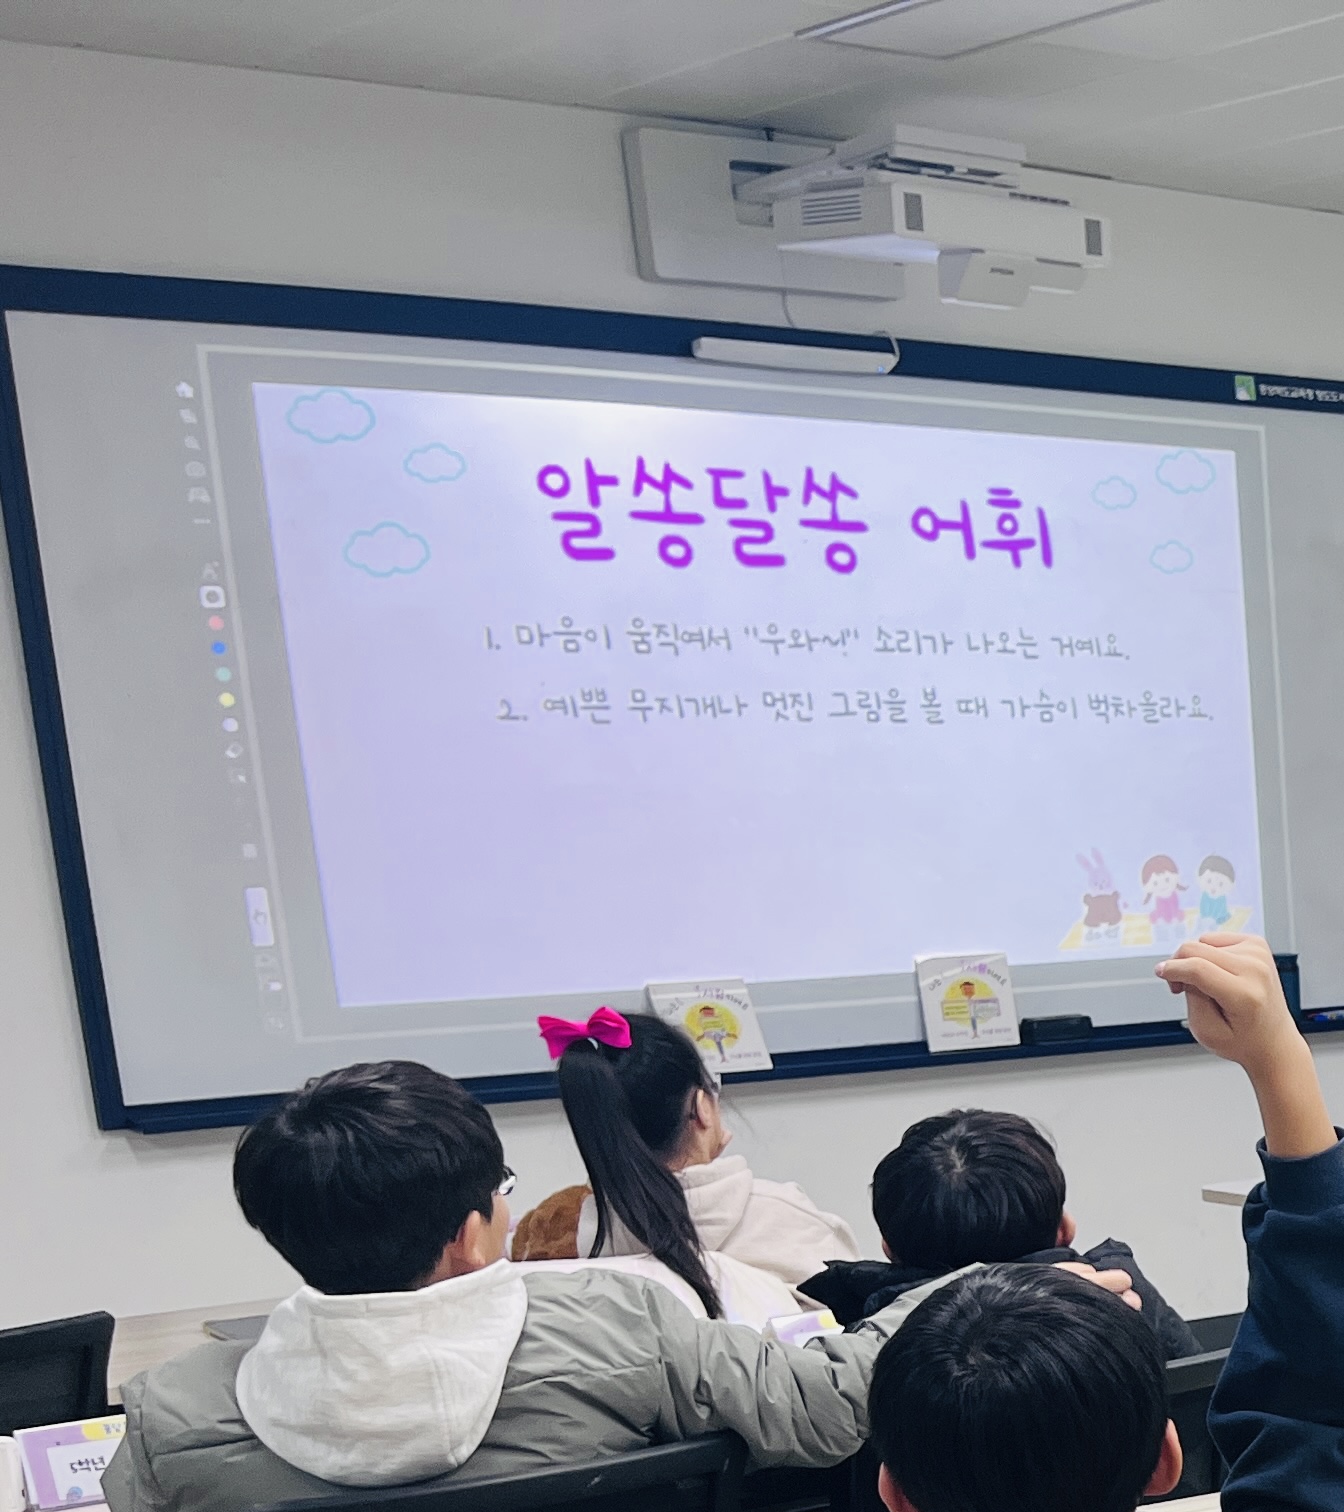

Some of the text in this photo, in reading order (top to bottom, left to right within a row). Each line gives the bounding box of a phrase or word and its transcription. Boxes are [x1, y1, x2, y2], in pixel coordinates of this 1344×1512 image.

[536, 456, 1054, 574] 알쏭달쏭 어휘
[483, 625, 502, 650] 1.
[514, 615, 612, 654] 마음이
[626, 617, 732, 656] 움직여서
[873, 626, 954, 656] 소리가
[966, 627, 1040, 660] 나오는
[1050, 633, 1130, 661] 거예요.
[496, 685, 1214, 725] 2. 예쁜 무지개나 멋진 그림을 볼 때 가슴이 벅차올라요.
